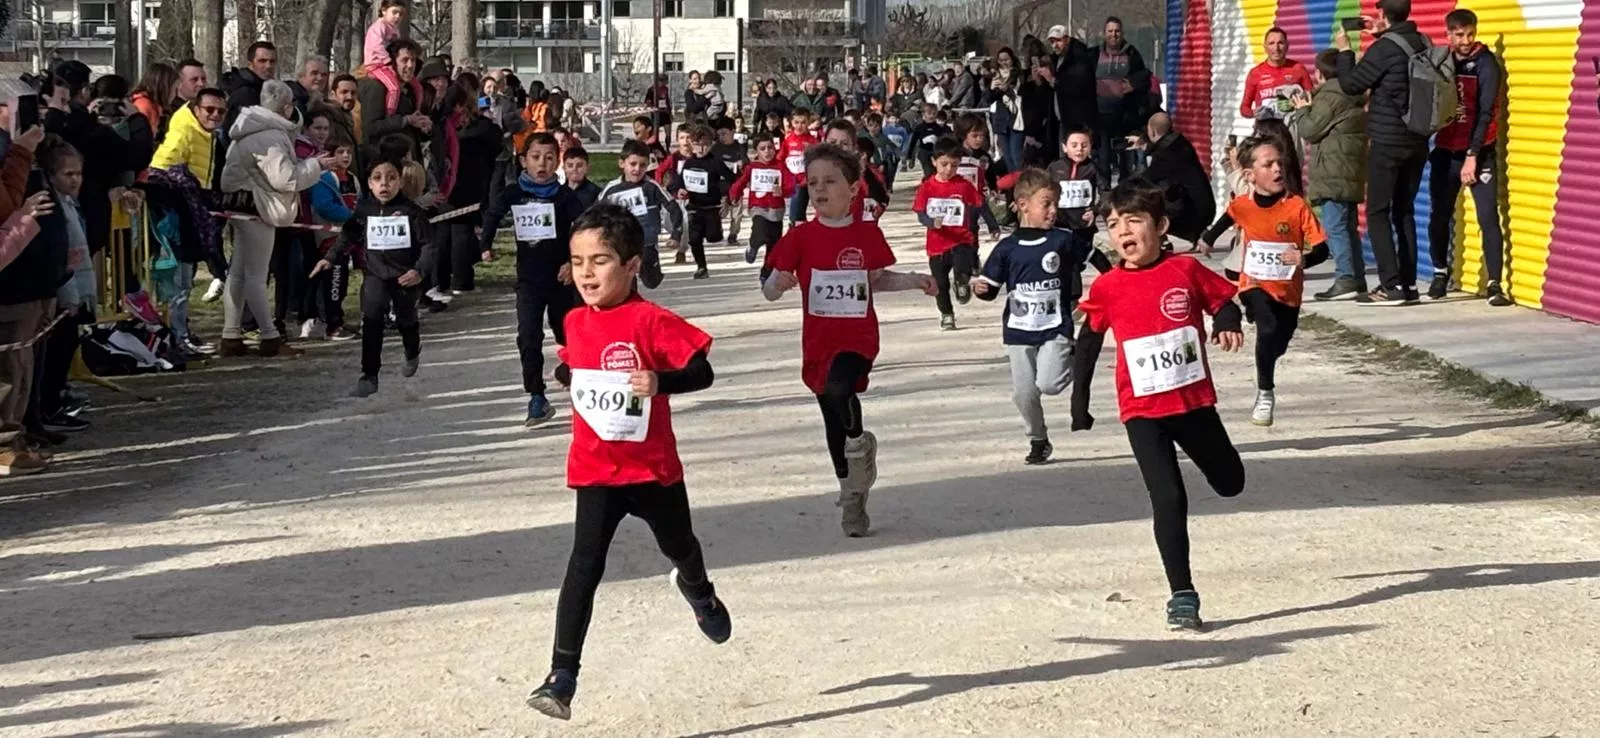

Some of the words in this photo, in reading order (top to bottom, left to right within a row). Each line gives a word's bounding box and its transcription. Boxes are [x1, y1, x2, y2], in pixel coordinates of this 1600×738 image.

[521, 215, 541, 227] 226
[376, 225, 395, 237] 371
[1257, 252, 1281, 265] 355
[825, 284, 855, 300] 234
[1022, 301, 1046, 315] 373
[1149, 347, 1183, 371] 186
[585, 389, 625, 412] 369
